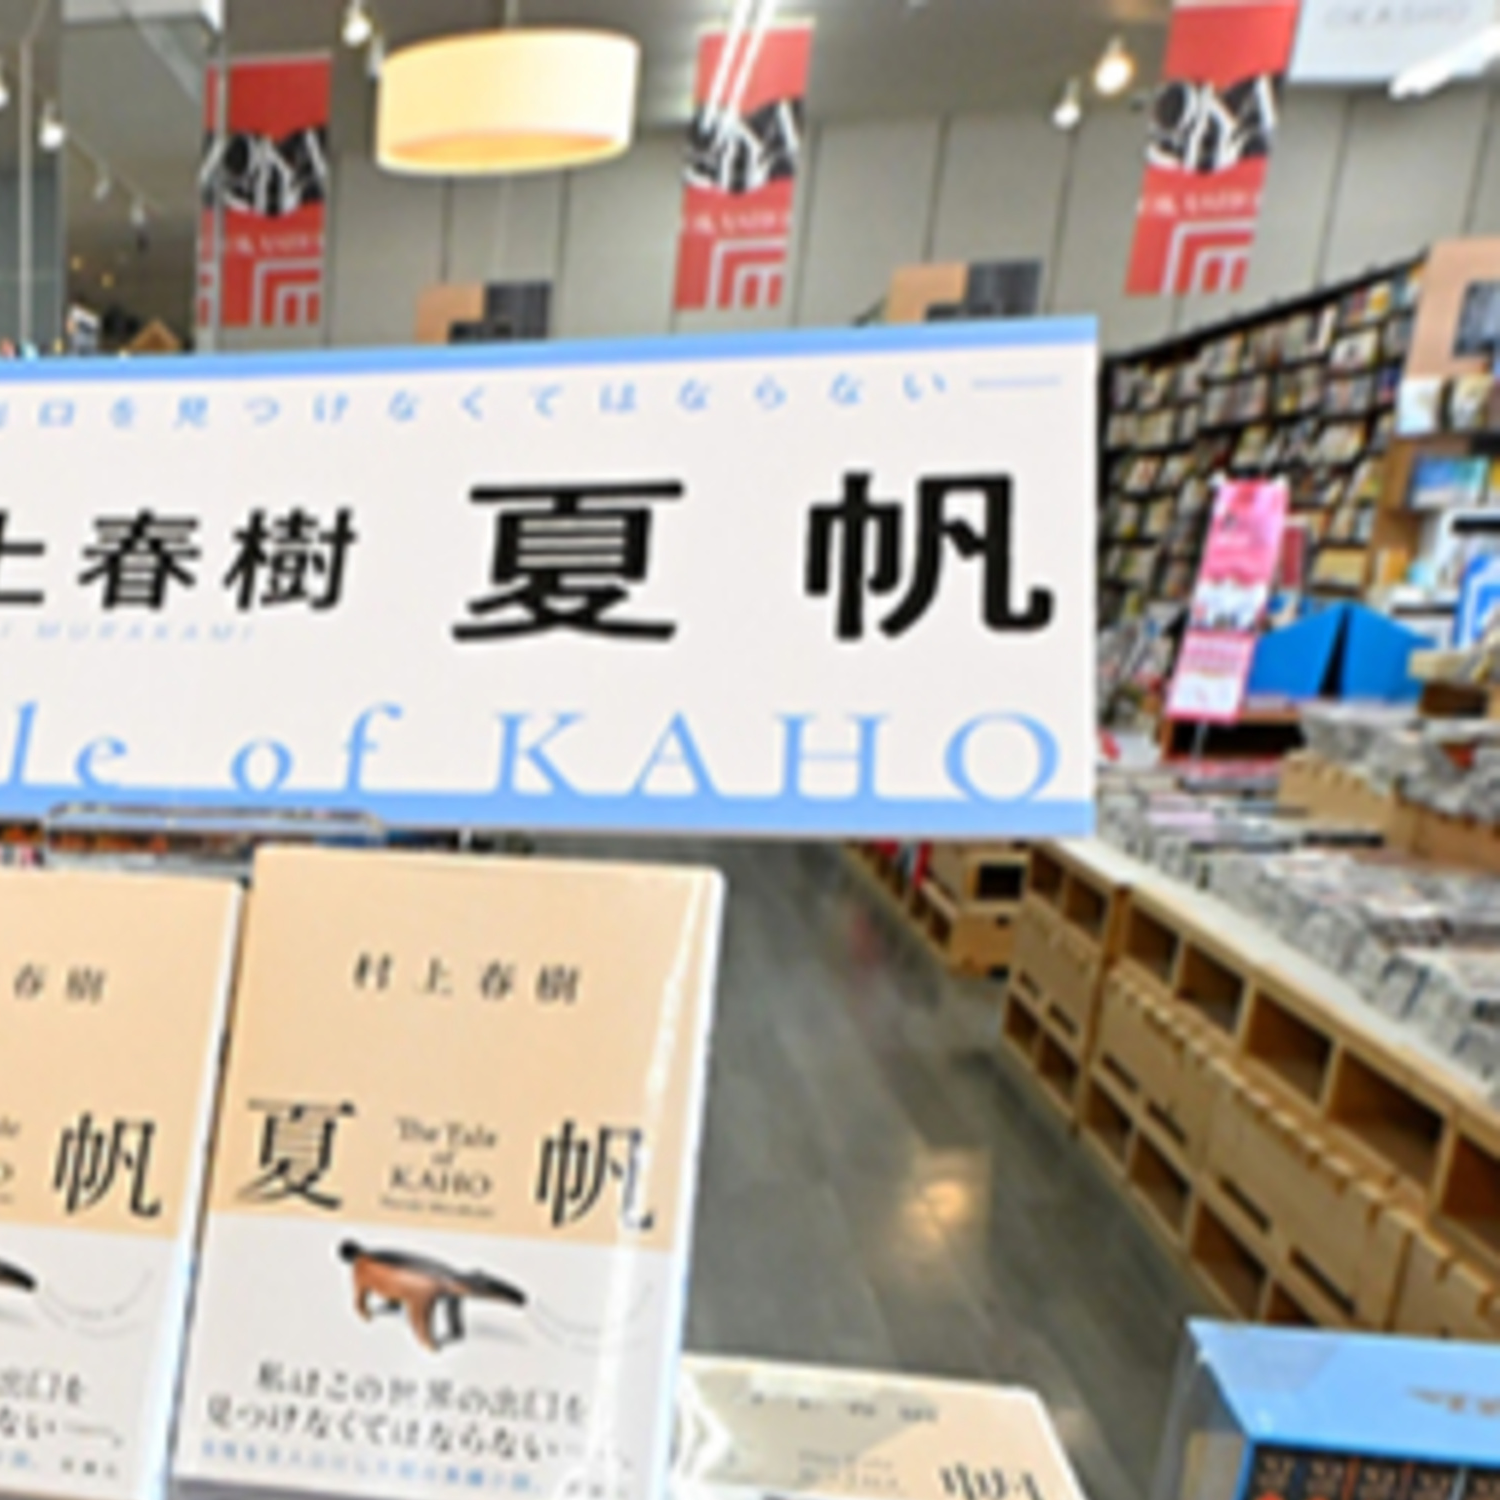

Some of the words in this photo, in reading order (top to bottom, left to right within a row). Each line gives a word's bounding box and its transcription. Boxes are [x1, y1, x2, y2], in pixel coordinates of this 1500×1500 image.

[229, 701, 404, 796] of
[494, 709, 1061, 806] KAHO
[353, 952, 581, 1005] 村上春樹
[53, 1112, 162, 1219] 帆
[235, 1098, 356, 1211] 夏
[536, 1119, 656, 1230] 帆
